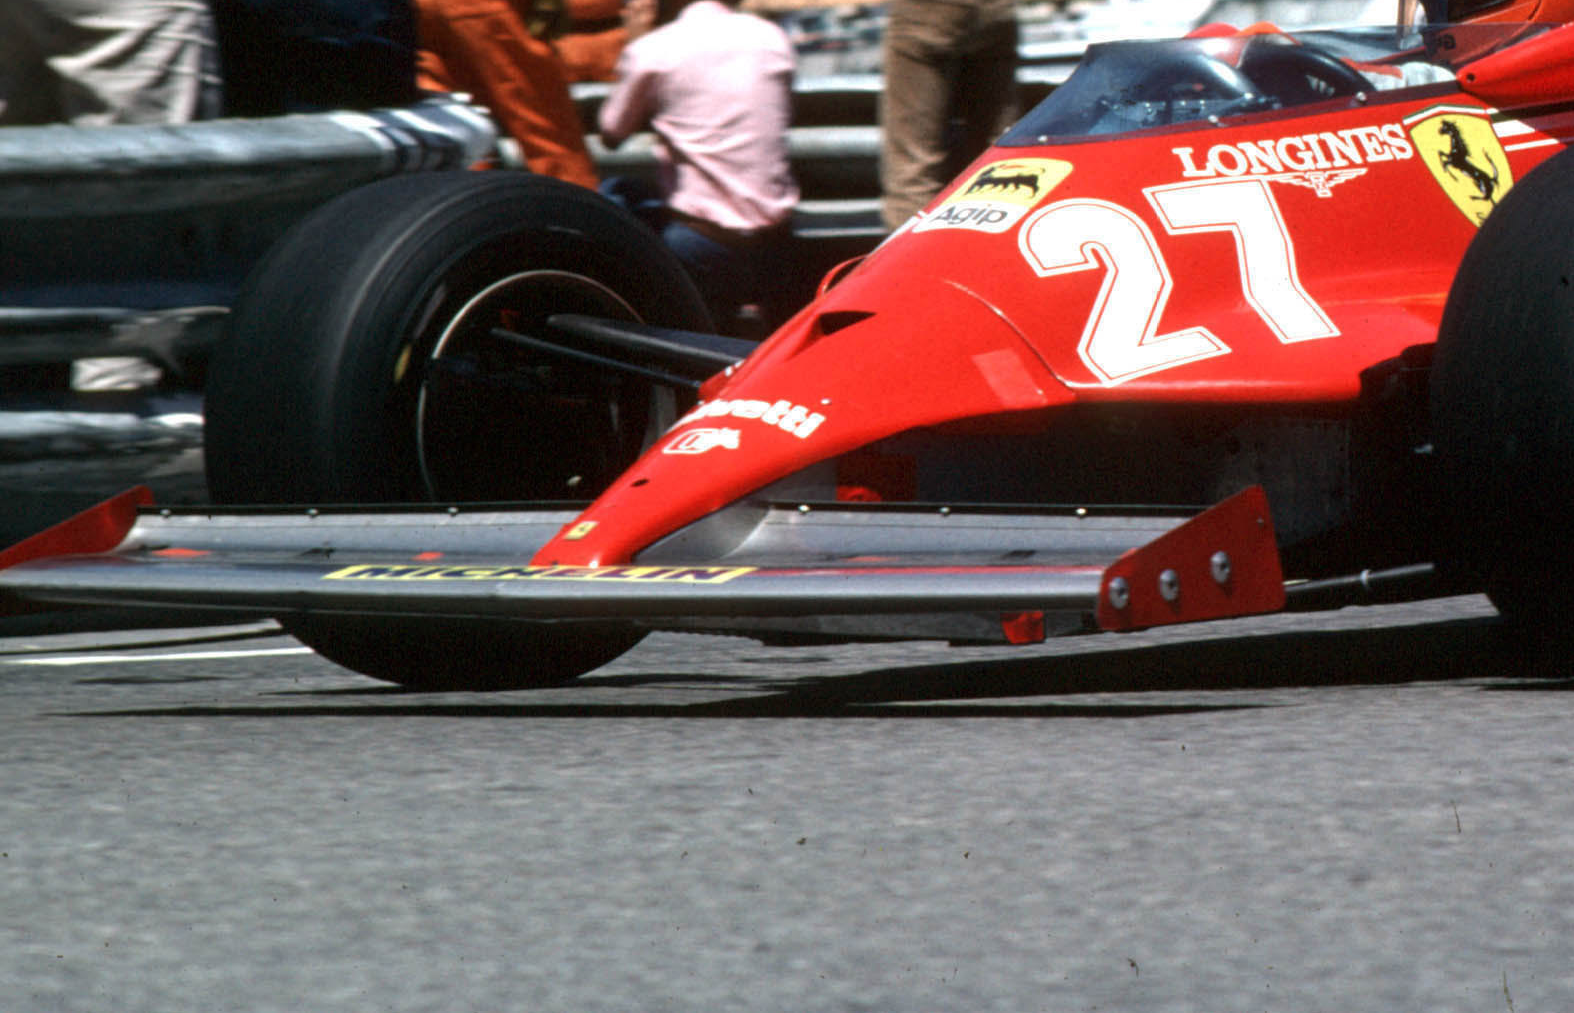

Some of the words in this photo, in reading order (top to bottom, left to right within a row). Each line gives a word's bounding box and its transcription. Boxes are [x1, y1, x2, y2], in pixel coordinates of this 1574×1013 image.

[1172, 124, 1414, 178] LONGINES
[930, 203, 1008, 225] Agip
[1017, 178, 1341, 388] 27
